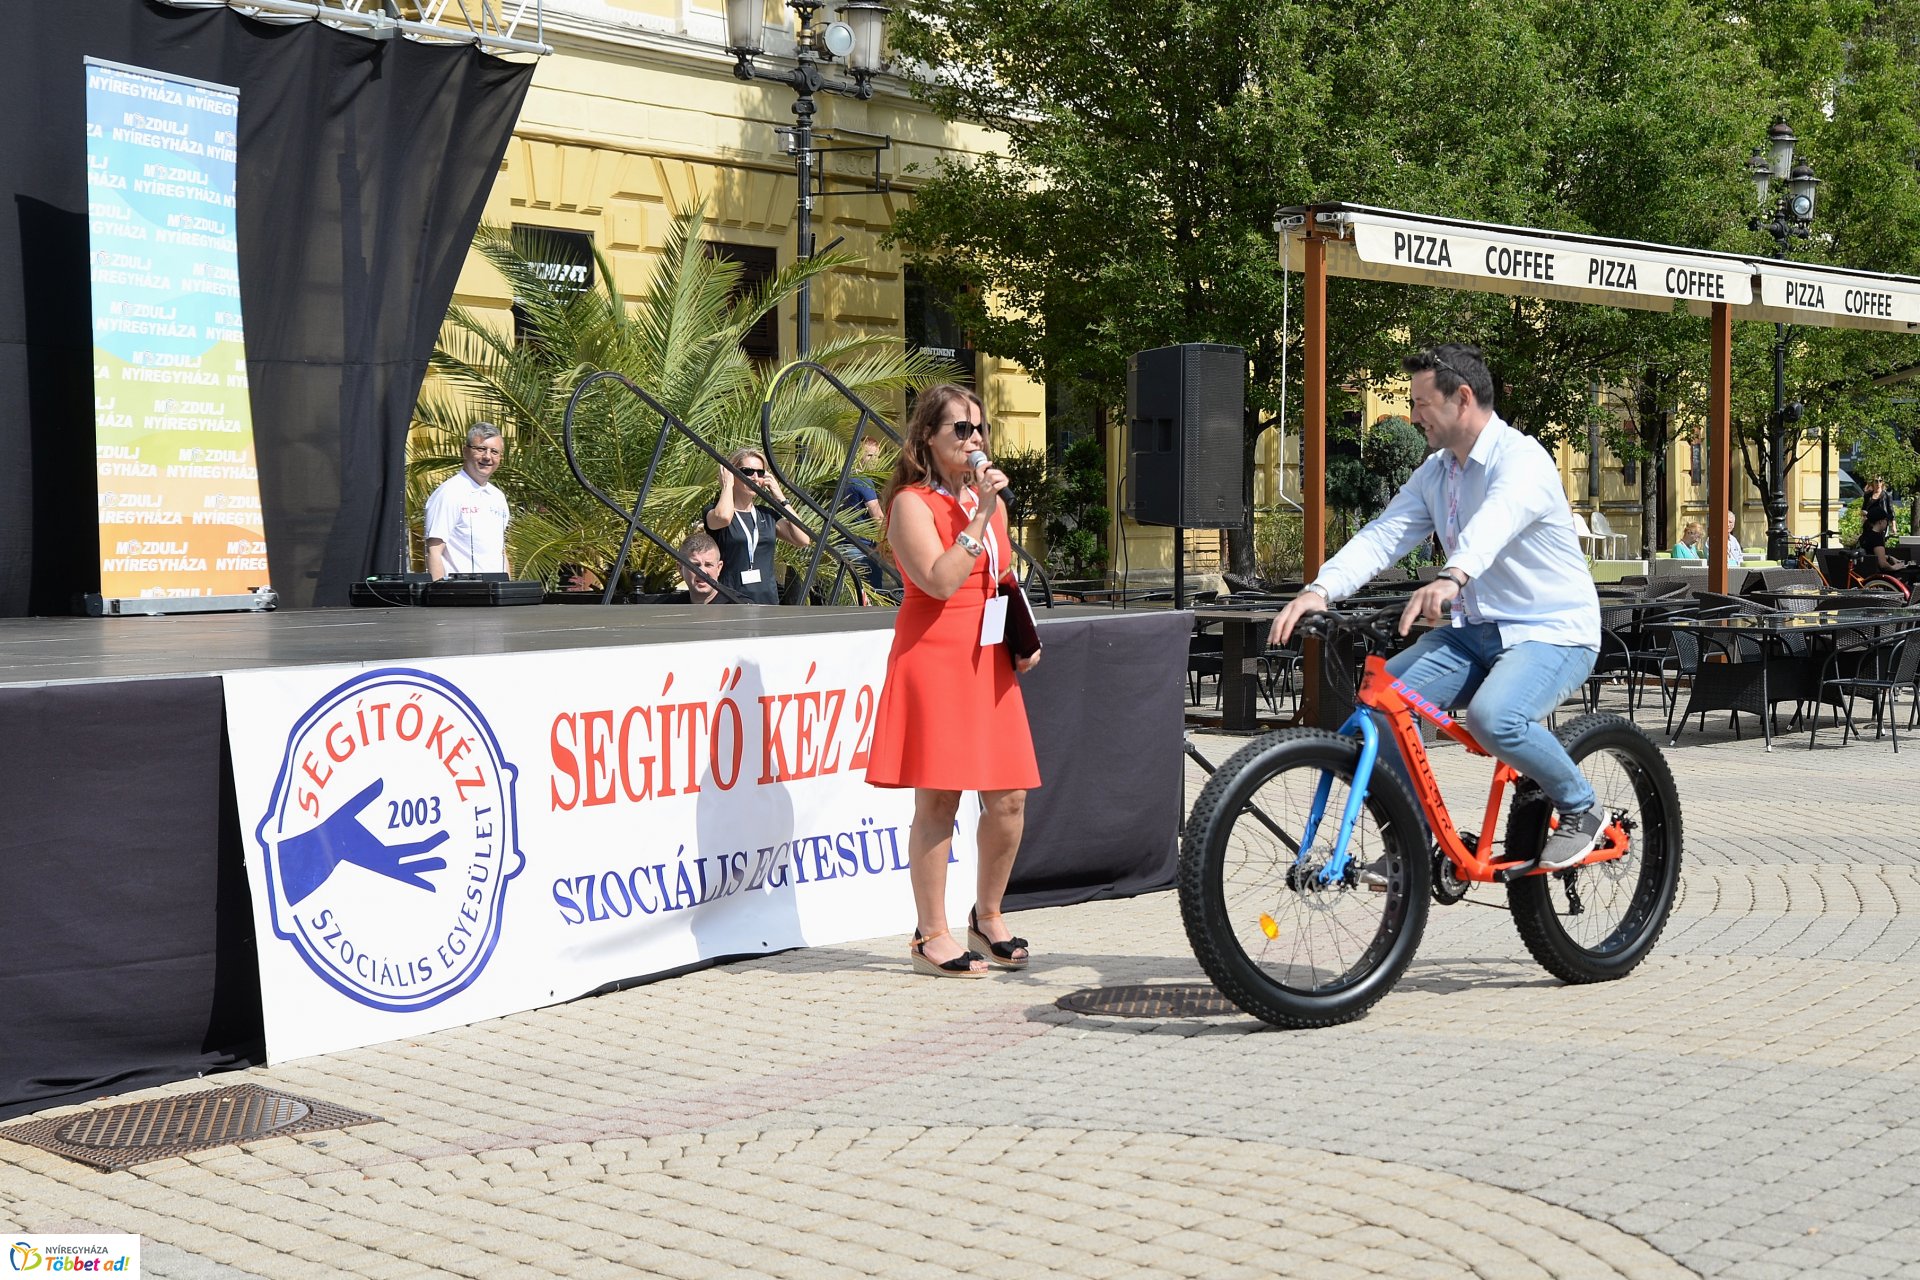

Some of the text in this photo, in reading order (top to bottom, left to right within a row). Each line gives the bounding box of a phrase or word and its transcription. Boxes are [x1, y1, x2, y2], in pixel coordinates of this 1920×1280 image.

[89, 75, 183, 106] NYÍREGYHÁZA
[112, 127, 204, 156] NYÍREGYHÁZA
[134, 179, 221, 206] NYÍREGYHÁZA
[1394, 231, 1452, 267] PIZZA
[1485, 245, 1554, 281] COFFEE
[1588, 258, 1637, 290] PIZZA
[1665, 267, 1725, 299] COFFEE
[1786, 280, 1892, 317] PIZZA COFFEE
[96, 317, 197, 339] NYÍREGYHÁZA
[122, 368, 220, 387] NYÍREGYHÁZA
[144, 414, 242, 433] NYÍREGYHÁZA
[98, 461, 158, 478] GYHÁZA
[103, 556, 207, 572] NYÍREGYHÁZA
[551, 666, 744, 813] SEGÍTŐ
[757, 661, 846, 786] KÉZ
[387, 796, 442, 829] 2003
[552, 817, 960, 925] SZOCIÁLIS EGYESÜL
[312, 805, 492, 988] SZOCIÁLIS EGYESÜLET
